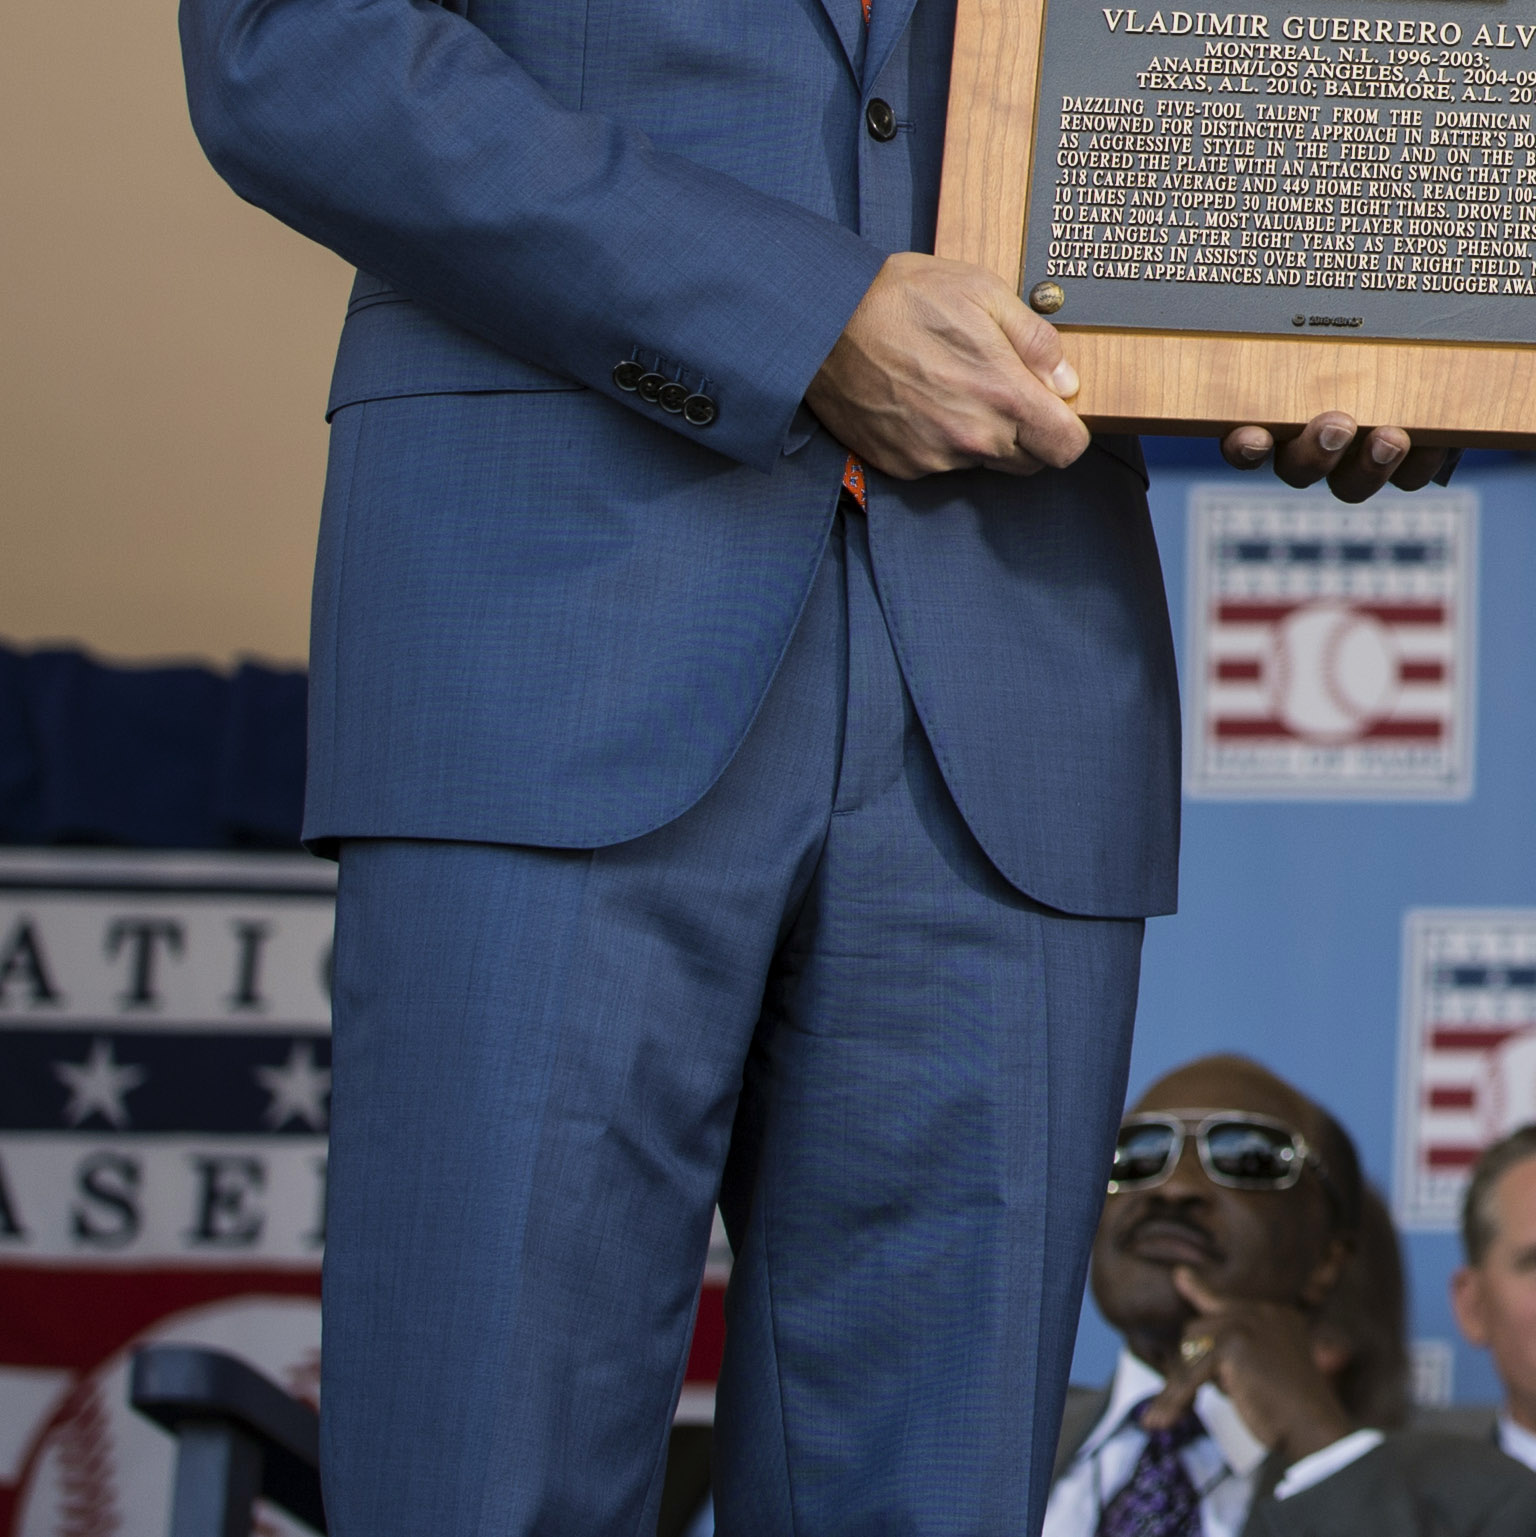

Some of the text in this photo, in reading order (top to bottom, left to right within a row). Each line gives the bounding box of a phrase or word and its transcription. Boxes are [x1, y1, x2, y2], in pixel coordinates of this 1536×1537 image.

[1102, 8, 1270, 38] VLADIMIR
[1282, 16, 1462, 45] GUERRERO
[1146, 56, 1298, 77] ANAHEIM/LOS
[1303, 61, 1410, 83] ANGELES,
[1414, 66, 1456, 83] A.L.
[1204, 41, 1490, 69] MONTREAL, N.L. 1996-2003;
[1136, 72, 1213, 93] TEXAS,
[1217, 76, 1259, 93] A.L.
[1265, 77, 1317, 97] 2010;
[1323, 79, 1456, 103] BALTIMORE,
[1461, 85, 1502, 102] A.L.
[1061, 95, 1144, 115] DAZZLING
[1156, 99, 1245, 119] FIVE-TOOL
[1255, 103, 1321, 122] TALENT
[1332, 106, 1379, 124] FROM
[1389, 109, 1423, 126] THE
[1435, 110, 1531, 130] DOMINICAN
[1060, 113, 1154, 133] RENOWNED
[1160, 118, 1193, 135] FOR
[1200, 119, 1305, 139] DISTINCTIVE
[1310, 124, 1398, 143] APPROACH
[1404, 127, 1423, 144] IN
[1429, 128, 1507, 147] BATTER'S
[1058, 132, 1079, 149] AS
[1088, 133, 1192, 153] AGGRESSIVE
[1203, 138, 1255, 156] STYLE
[1266, 140, 1286, 157] IN
[1295, 141, 1329, 159] THE
[1339, 143, 1390, 161] FIELD
[1399, 146, 1436, 163] AND
[1447, 147, 1471, 164] ON
[1481, 148, 1514, 166] THE
[1056, 150, 1133, 169] COVERED
[1137, 153, 1171, 170] THE
[1176, 155, 1228, 173] PLATE
[1233, 157, 1277, 175] WITH
[1280, 159, 1305, 176] AN
[1308, 160, 1402, 180] ATTACKING
[1408, 164, 1462, 182] SWING
[1467, 166, 1511, 184] THAT
[1055, 168, 1087, 186] .318
[1092, 170, 1157, 188] CAREER
[1162, 173, 1238, 191] AVERAGE
[1241, 176, 1277, 193] AND
[1282, 178, 1310, 194] 449
[1315, 179, 1363, 197] HOME
[1368, 181, 1416, 199] RUNS.
[1422, 183, 1500, 202] REACHED
[1055, 186, 1072, 203] 10
[1076, 187, 1126, 205] TIMES
[1130, 190, 1166, 207] AND
[1171, 191, 1236, 210] TOPPED
[1241, 194, 1260, 211] 30
[1266, 195, 1334, 214] HOMERS
[1340, 198, 1392, 216] EIGHT
[1396, 200, 1450, 218] TIMES.
[1457, 202, 1512, 221] DROVE
[1518, 205, 1536, 221] IN
[1052, 204, 1074, 221] TO
[1078, 205, 1124, 223] EARN
[1127, 208, 1164, 225] 2004
[1167, 209, 1199, 226] A.L.
[1204, 211, 1250, 229] MOST
[1253, 213, 1336, 232] VALUABLE
[1340, 216, 1403, 235] PLAYER
[1408, 219, 1476, 238] HONORS
[1480, 222, 1499, 238] IN
[1051, 222, 1095, 241] WITH
[1102, 225, 1169, 244] ANGELS
[1176, 228, 1231, 246] AFTER
[1241, 231, 1294, 249] EIGHT
[1302, 233, 1355, 251] YEARS
[1363, 236, 1384, 252] AS
[1393, 236, 1447, 255] EXPOS
[1456, 239, 1533, 258] PHENOM.
[1048, 241, 1164, 262] OUTFIELDERS
[1169, 246, 1189, 262] IN
[1193, 247, 1258, 266] ASSISTS
[1263, 250, 1307, 268] OVER
[1312, 252, 1380, 270] TENURE
[1386, 254, 1405, 271] IN
[1411, 256, 1465, 274] RIGHT
[1470, 258, 1524, 276] FIELD.
[1046, 259, 1088, 277] STAR
[1092, 261, 1140, 279] GAME
[1143, 263, 1262, 284] APPEARANCES
[1265, 268, 1301, 285] AND
[1305, 269, 1358, 288] EIGHT
[1360, 272, 1417, 290] SILVER
[1422, 274, 1499, 294] SLUGGER
[0, 912, 337, 1014] ATI
[0, 1149, 328, 1246] SE
